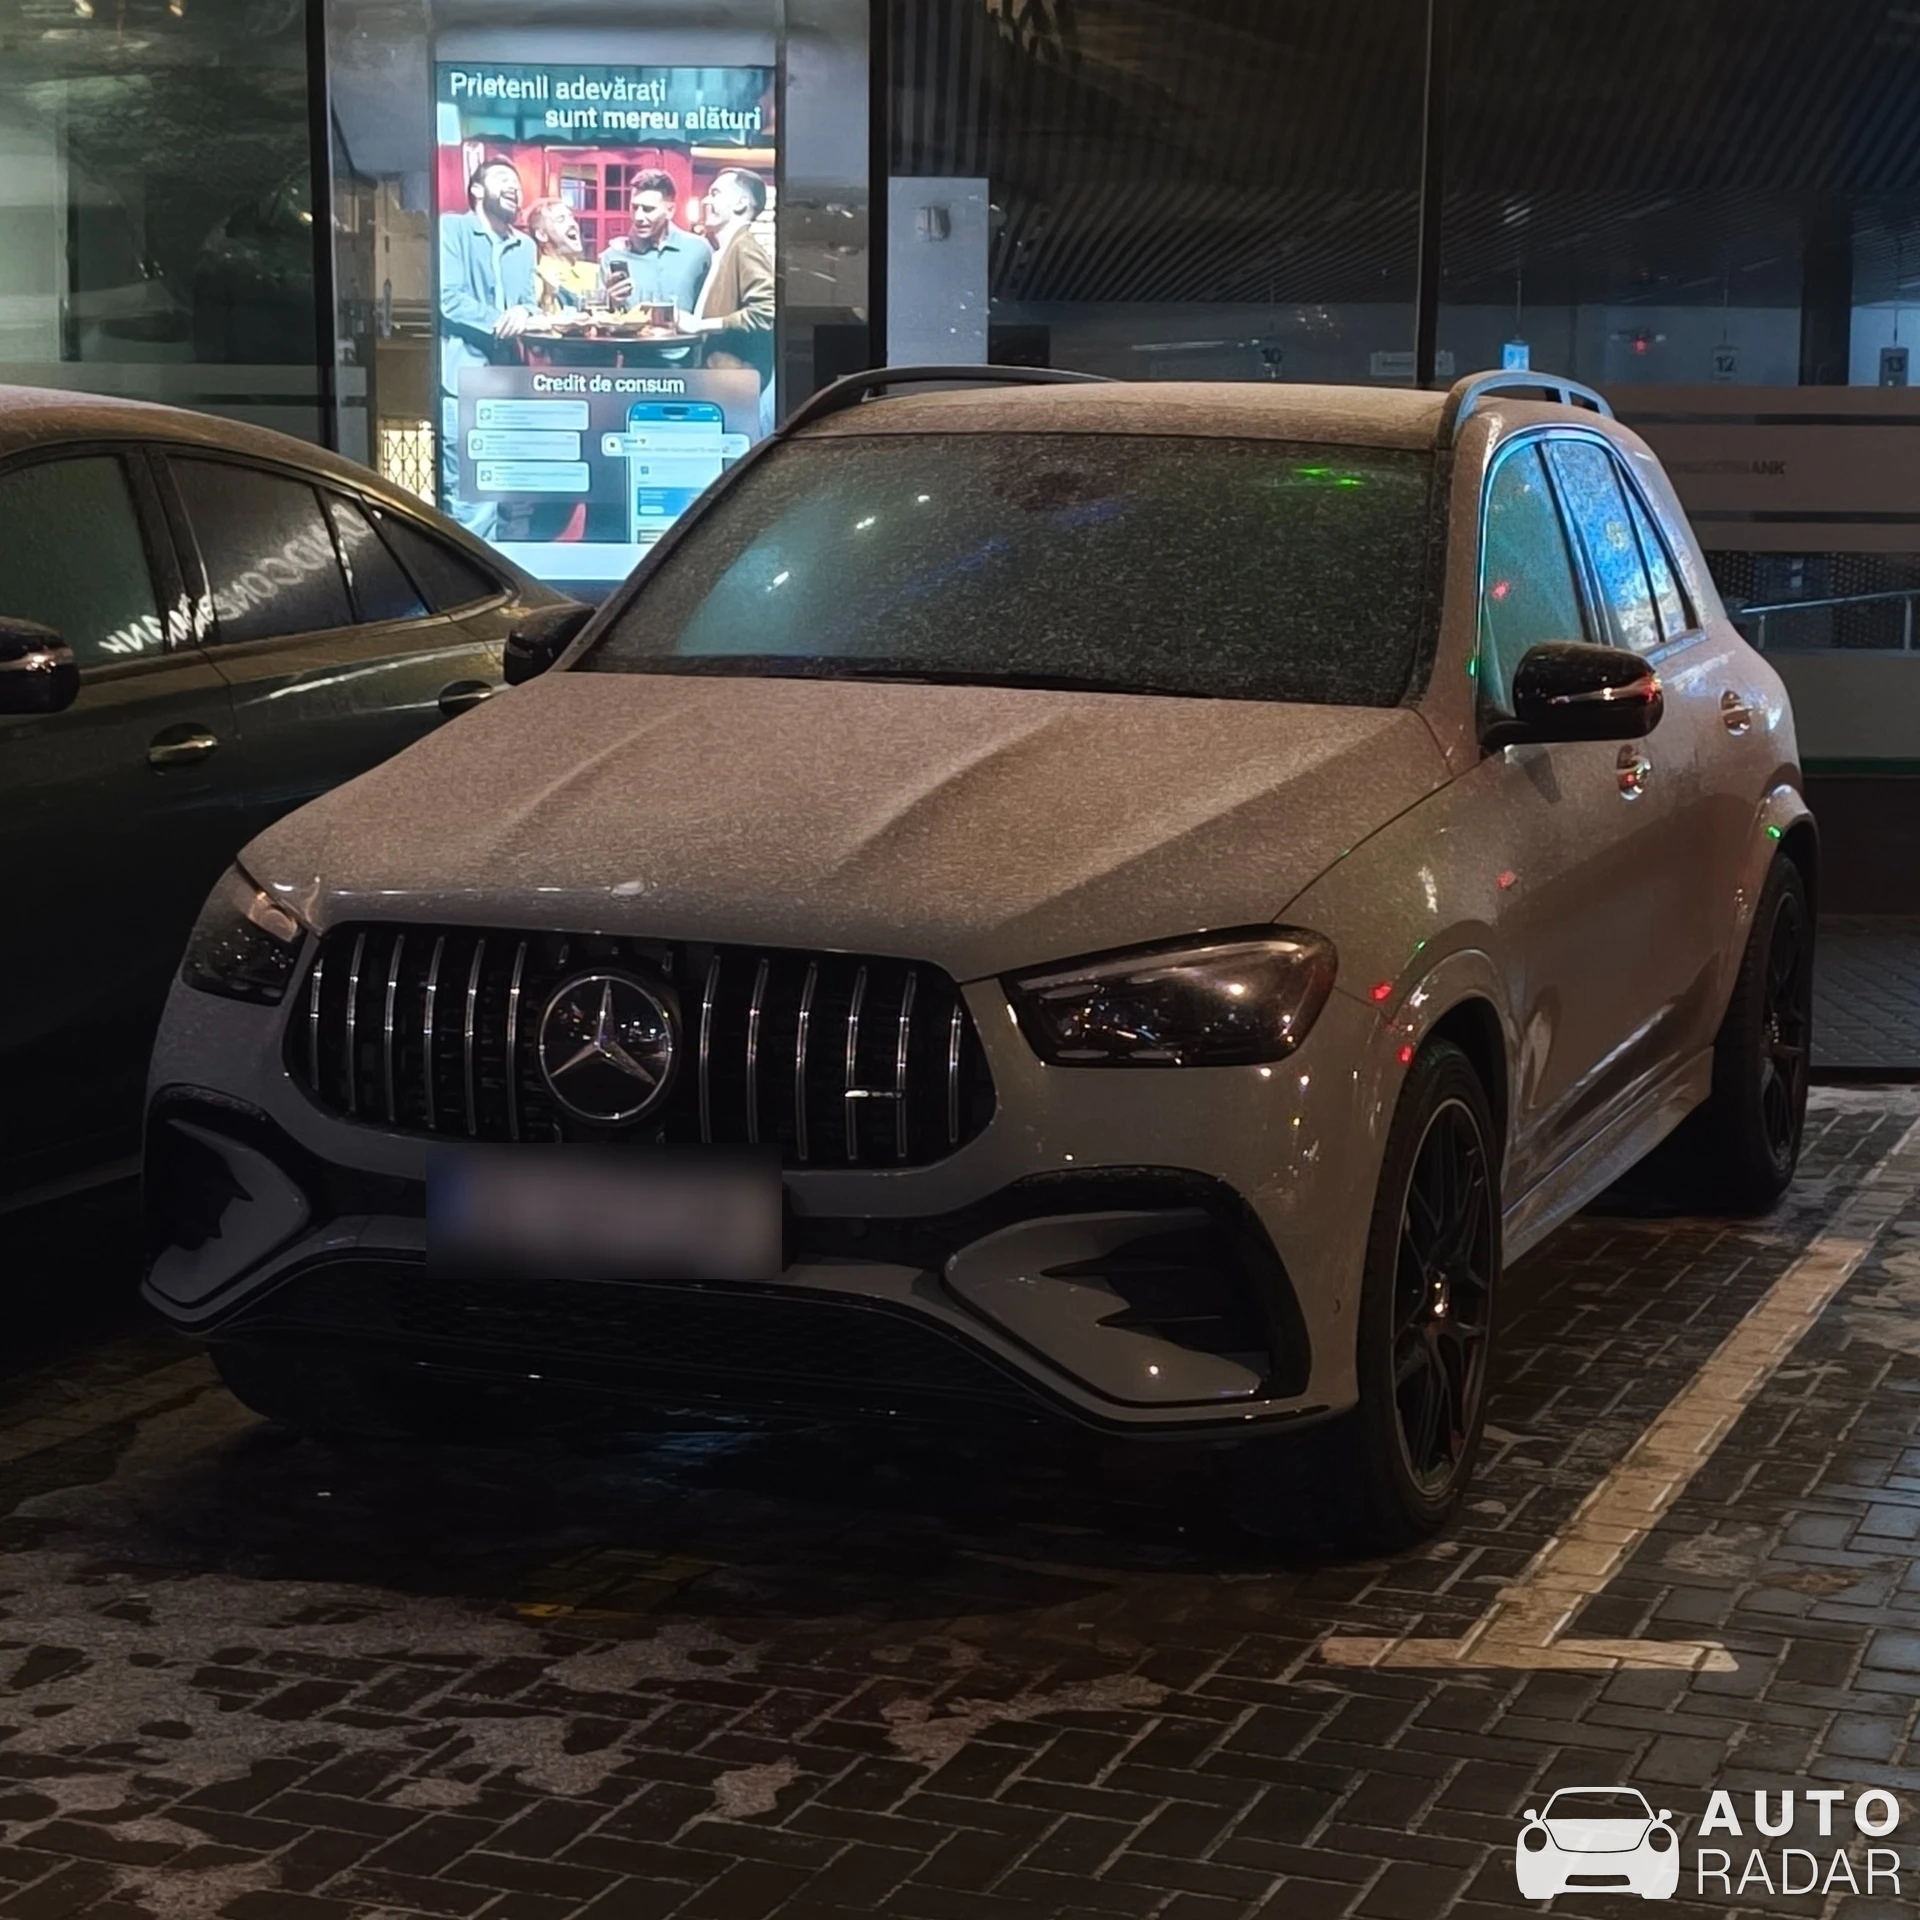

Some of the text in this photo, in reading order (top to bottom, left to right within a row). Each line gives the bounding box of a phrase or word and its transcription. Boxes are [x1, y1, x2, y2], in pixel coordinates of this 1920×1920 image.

[545, 106, 761, 131] sunt mereu alături
[1715, 356, 1736, 372] 12
[532, 373, 685, 394] Credit de consum
